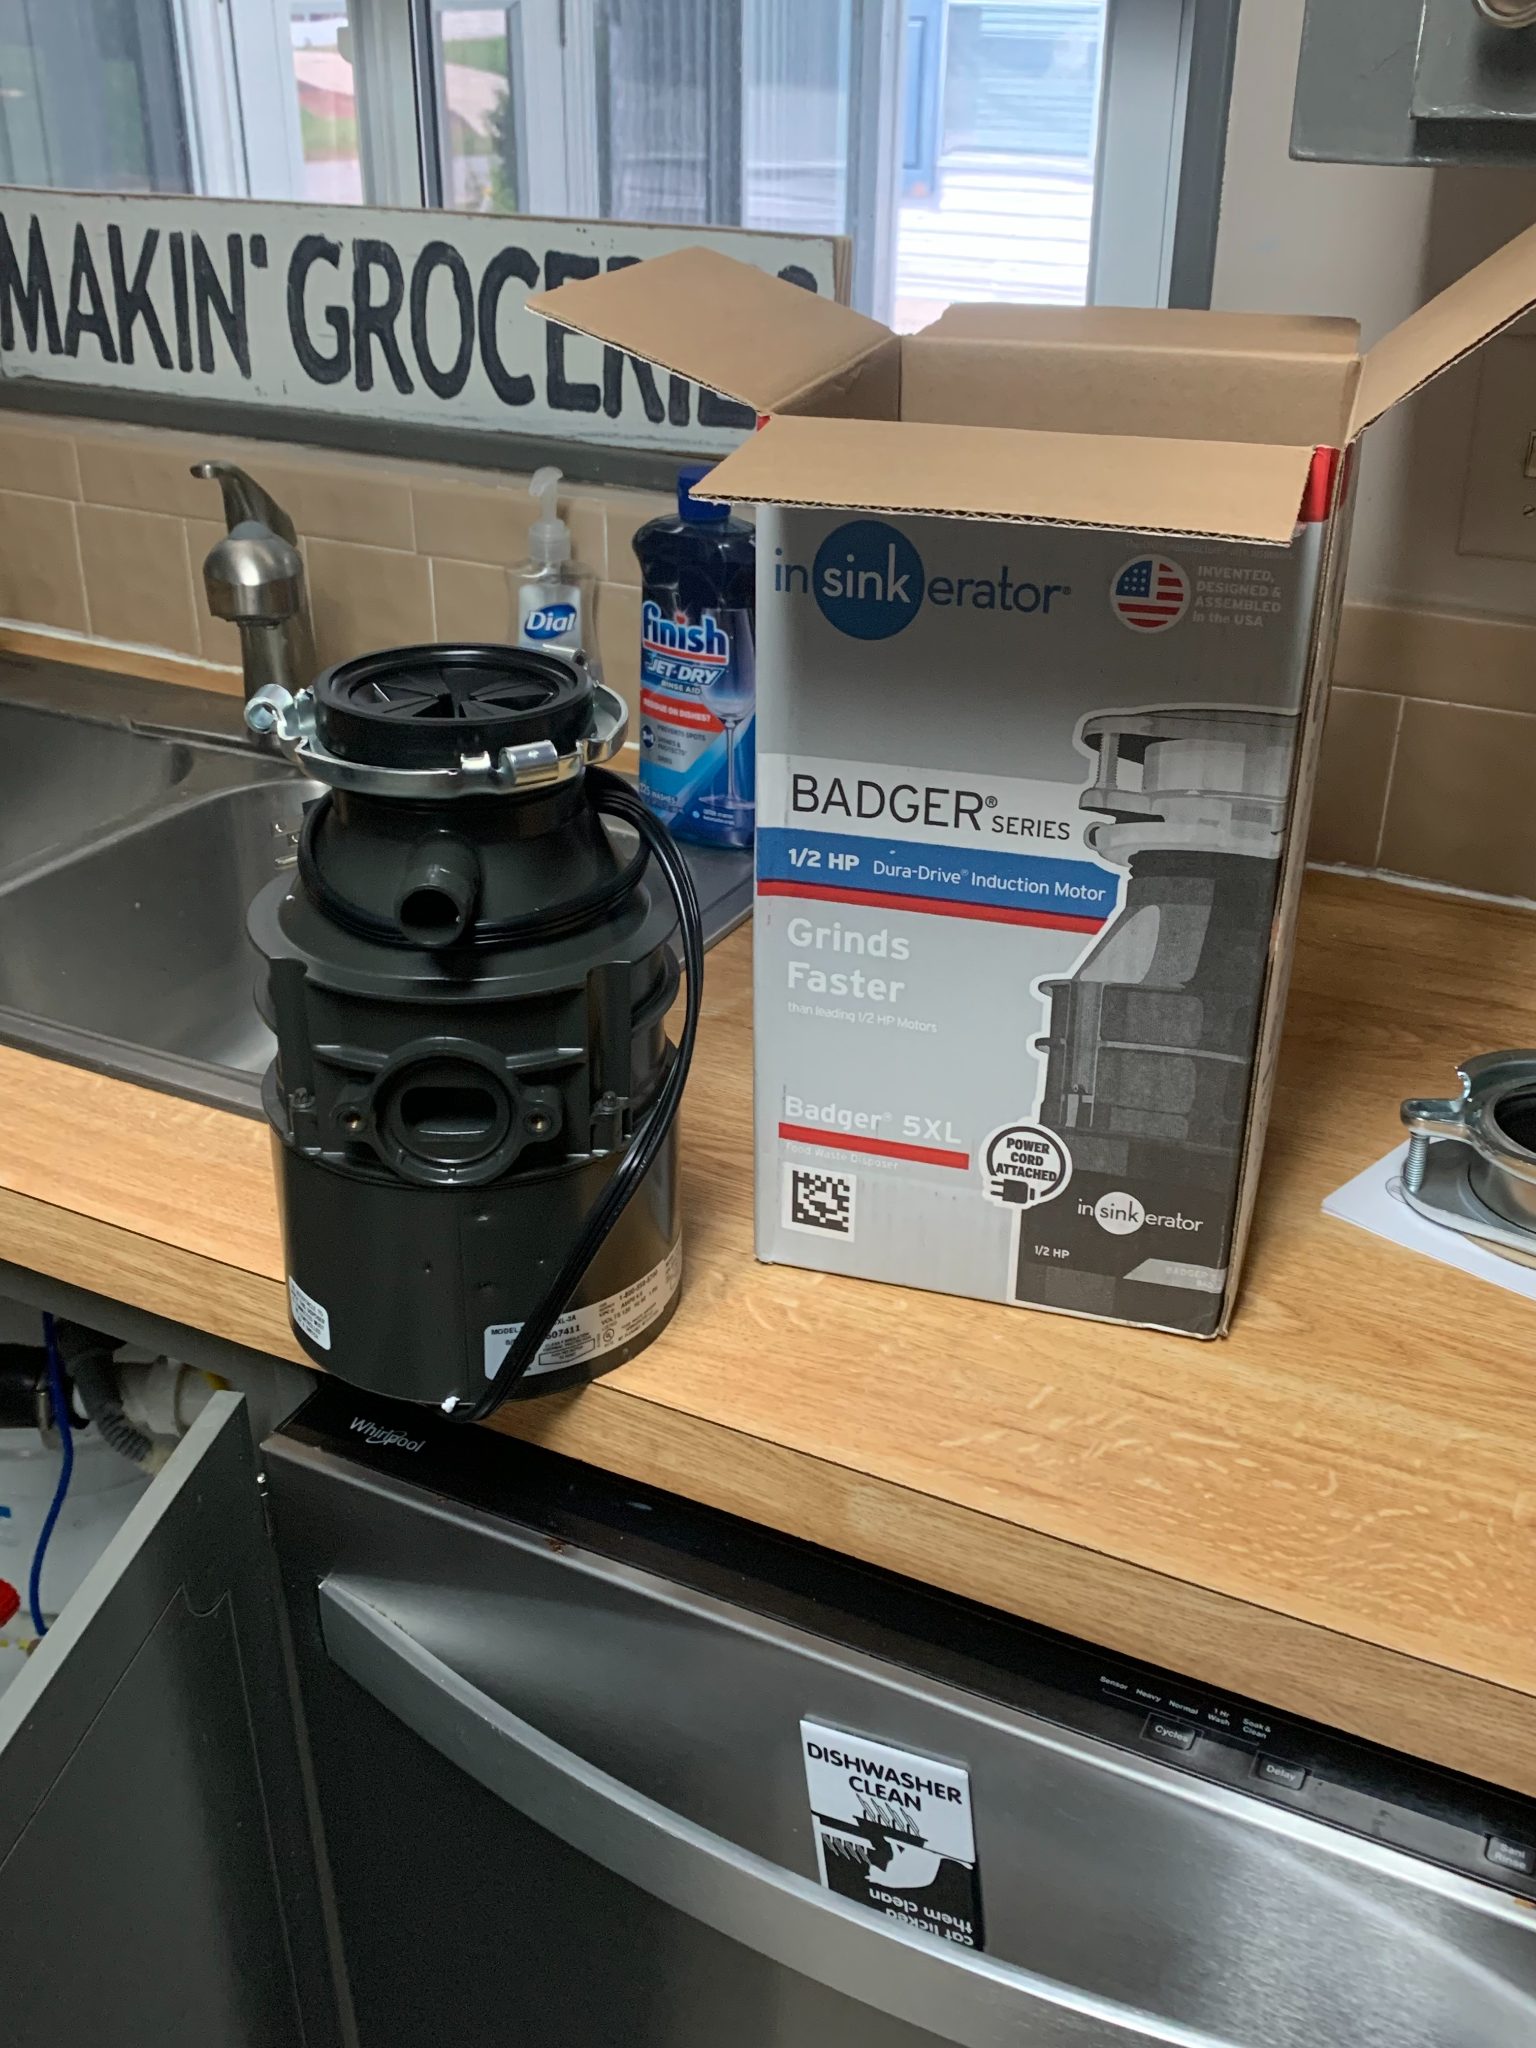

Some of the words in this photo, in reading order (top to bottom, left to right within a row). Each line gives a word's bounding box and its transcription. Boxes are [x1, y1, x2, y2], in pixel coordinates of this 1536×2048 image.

[287, 232, 818, 430] GROCER
[1196, 580, 1269, 597] DESIGNED
[1271, 586, 1282, 599] &
[1194, 595, 1282, 613] ASSEMBLED
[527, 609, 577, 632] Dial
[1209, 612, 1231, 624] the
[1234, 614, 1264, 627] USA
[991, 816, 1071, 841] SERIES
[788, 848, 821, 868] 1/2
[828, 852, 861, 871] HP
[971, 872, 1050, 896] Induction
[1054, 882, 1106, 902] Motor
[787, 917, 910, 961] Grinds
[787, 961, 906, 1003] Faster
[787, 1001, 813, 1015] than
[815, 1005, 856, 1024] leading
[858, 1011, 875, 1025] 1/2
[877, 1014, 896, 1026] HP
[897, 1017, 938, 1033] Motors
[902, 1114, 963, 1145] 5XL
[1006, 1137, 1051, 1155] POWER
[814, 1147, 848, 1162] Waste
[850, 1153, 899, 1171] Disposer
[1010, 1152, 1044, 1167] CORD
[996, 1162, 1058, 1183] ATTACHED
[1034, 1244, 1050, 1257] 1/2
[1052, 1248, 1070, 1260] HP
[491, 1327, 518, 1336] MODEL
[349, 1415, 427, 1455] Whirlpool
[1100, 1675, 1129, 1691] Sensor
[1135, 1688, 1162, 1703] Heavy
[1168, 1699, 1199, 1715] Normal
[1207, 1712, 1231, 1727] Wash
[1154, 1724, 1189, 1744] Cycles
[1242, 1726, 1268, 1740] Clean
[806, 1741, 963, 1805] DISHWASHER
[1266, 1763, 1297, 1783] Delay
[849, 1775, 921, 1812] CLEAN
[869, 1887, 919, 1915] clean
[925, 1905, 973, 1934] them
[945, 1926, 974, 1946] cat
